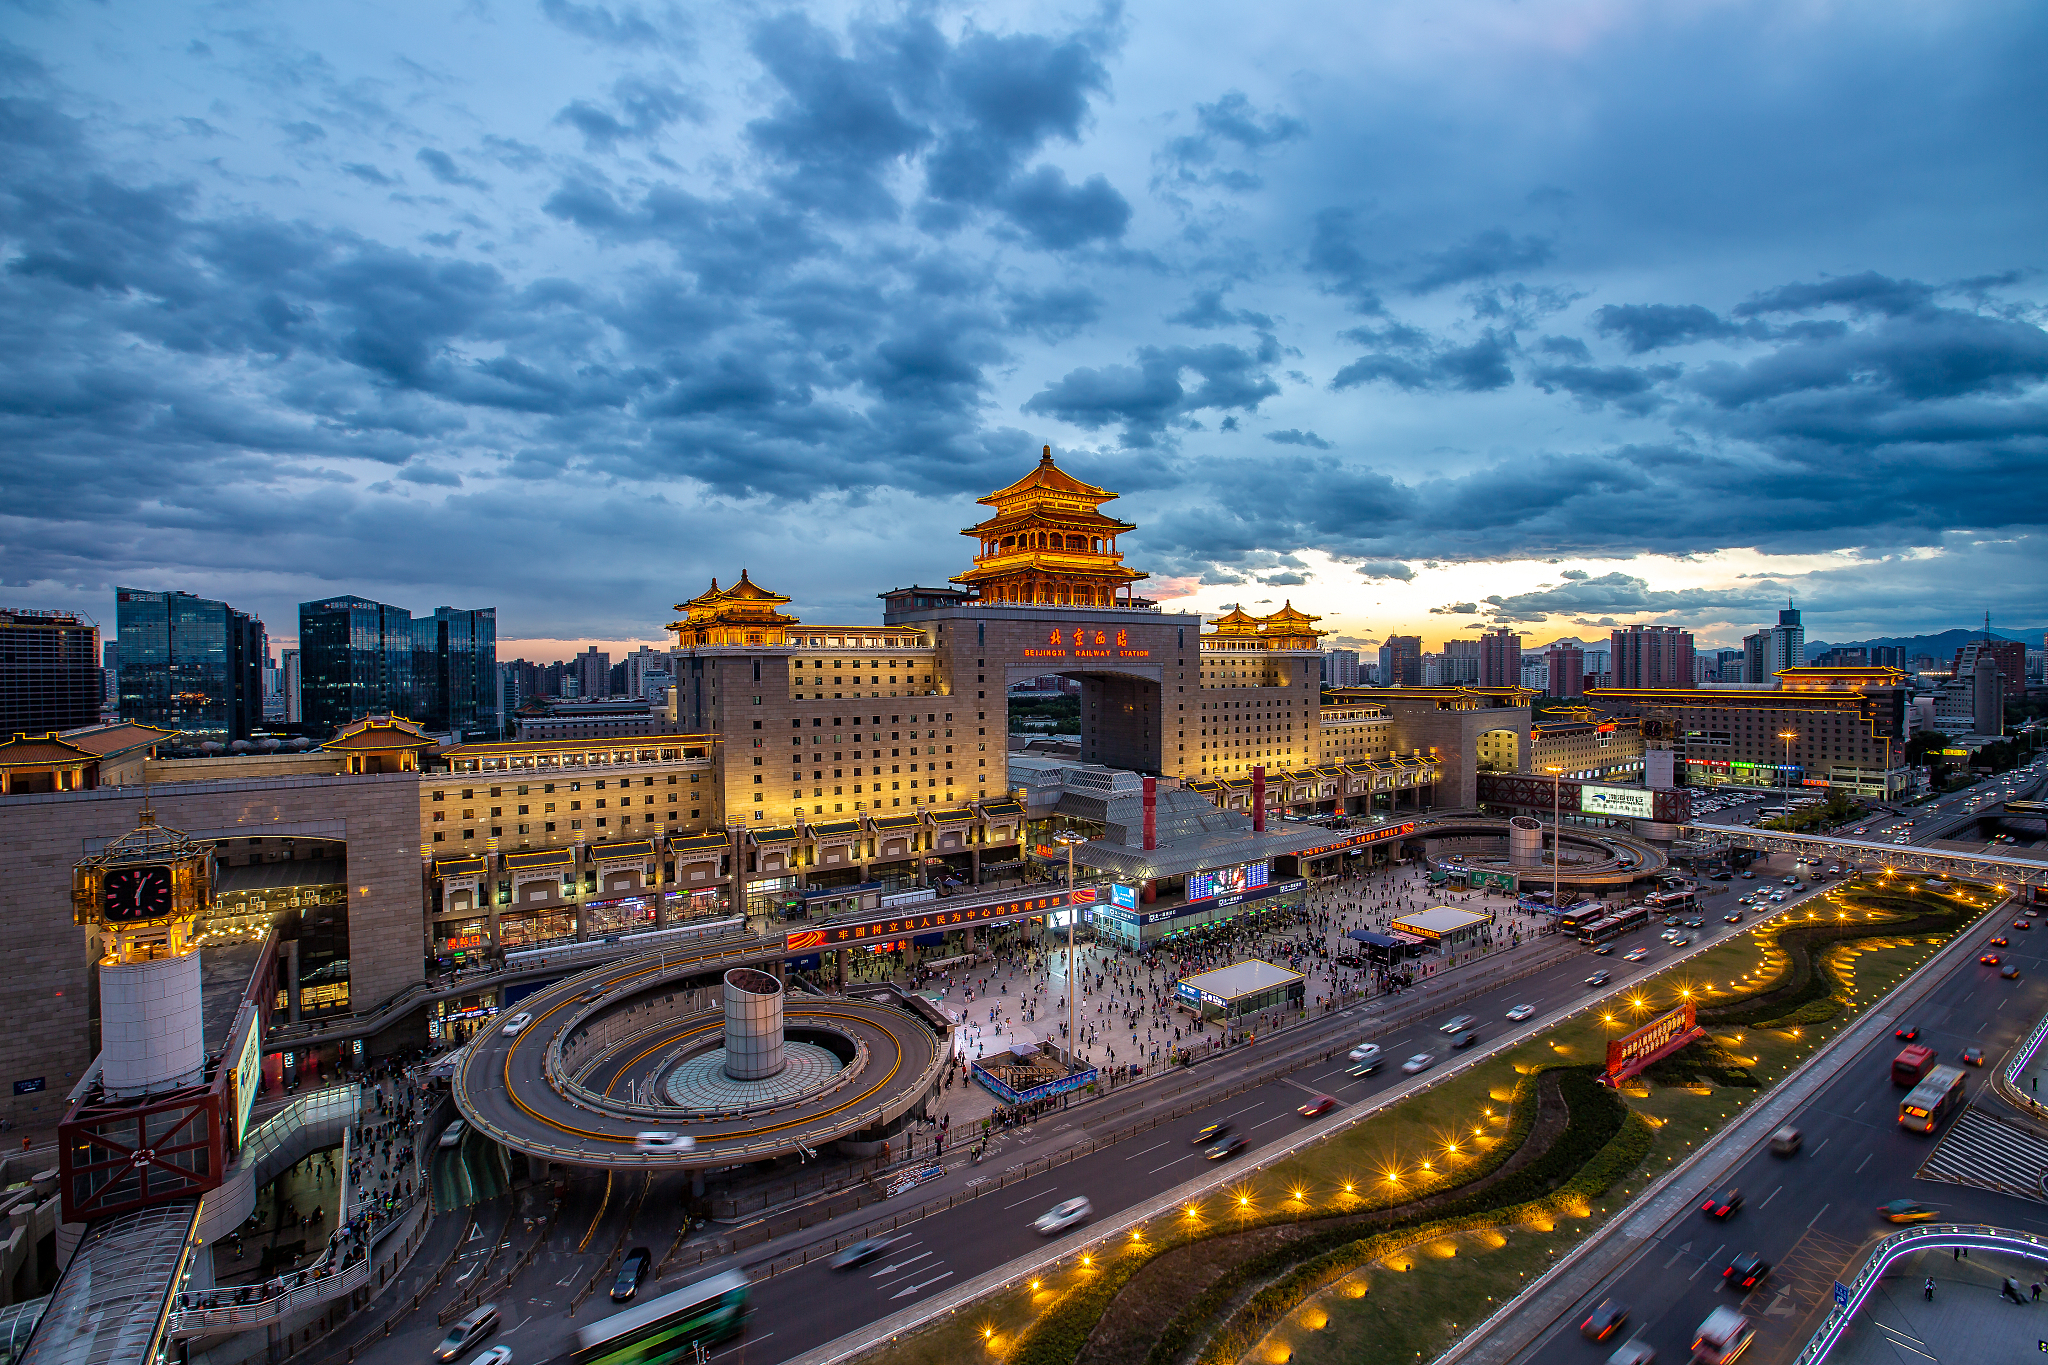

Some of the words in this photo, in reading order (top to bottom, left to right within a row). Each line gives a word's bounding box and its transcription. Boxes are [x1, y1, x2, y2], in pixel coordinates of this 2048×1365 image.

[1049, 627, 1127, 647] 北京西站
[1024, 649, 1066, 657] BEIJINGXI
[1075, 649, 1111, 657] RAILWAY
[838, 896, 1061, 940] 牢固树立以人民为中心的发展思想
[447, 935, 480, 947] 进站口
